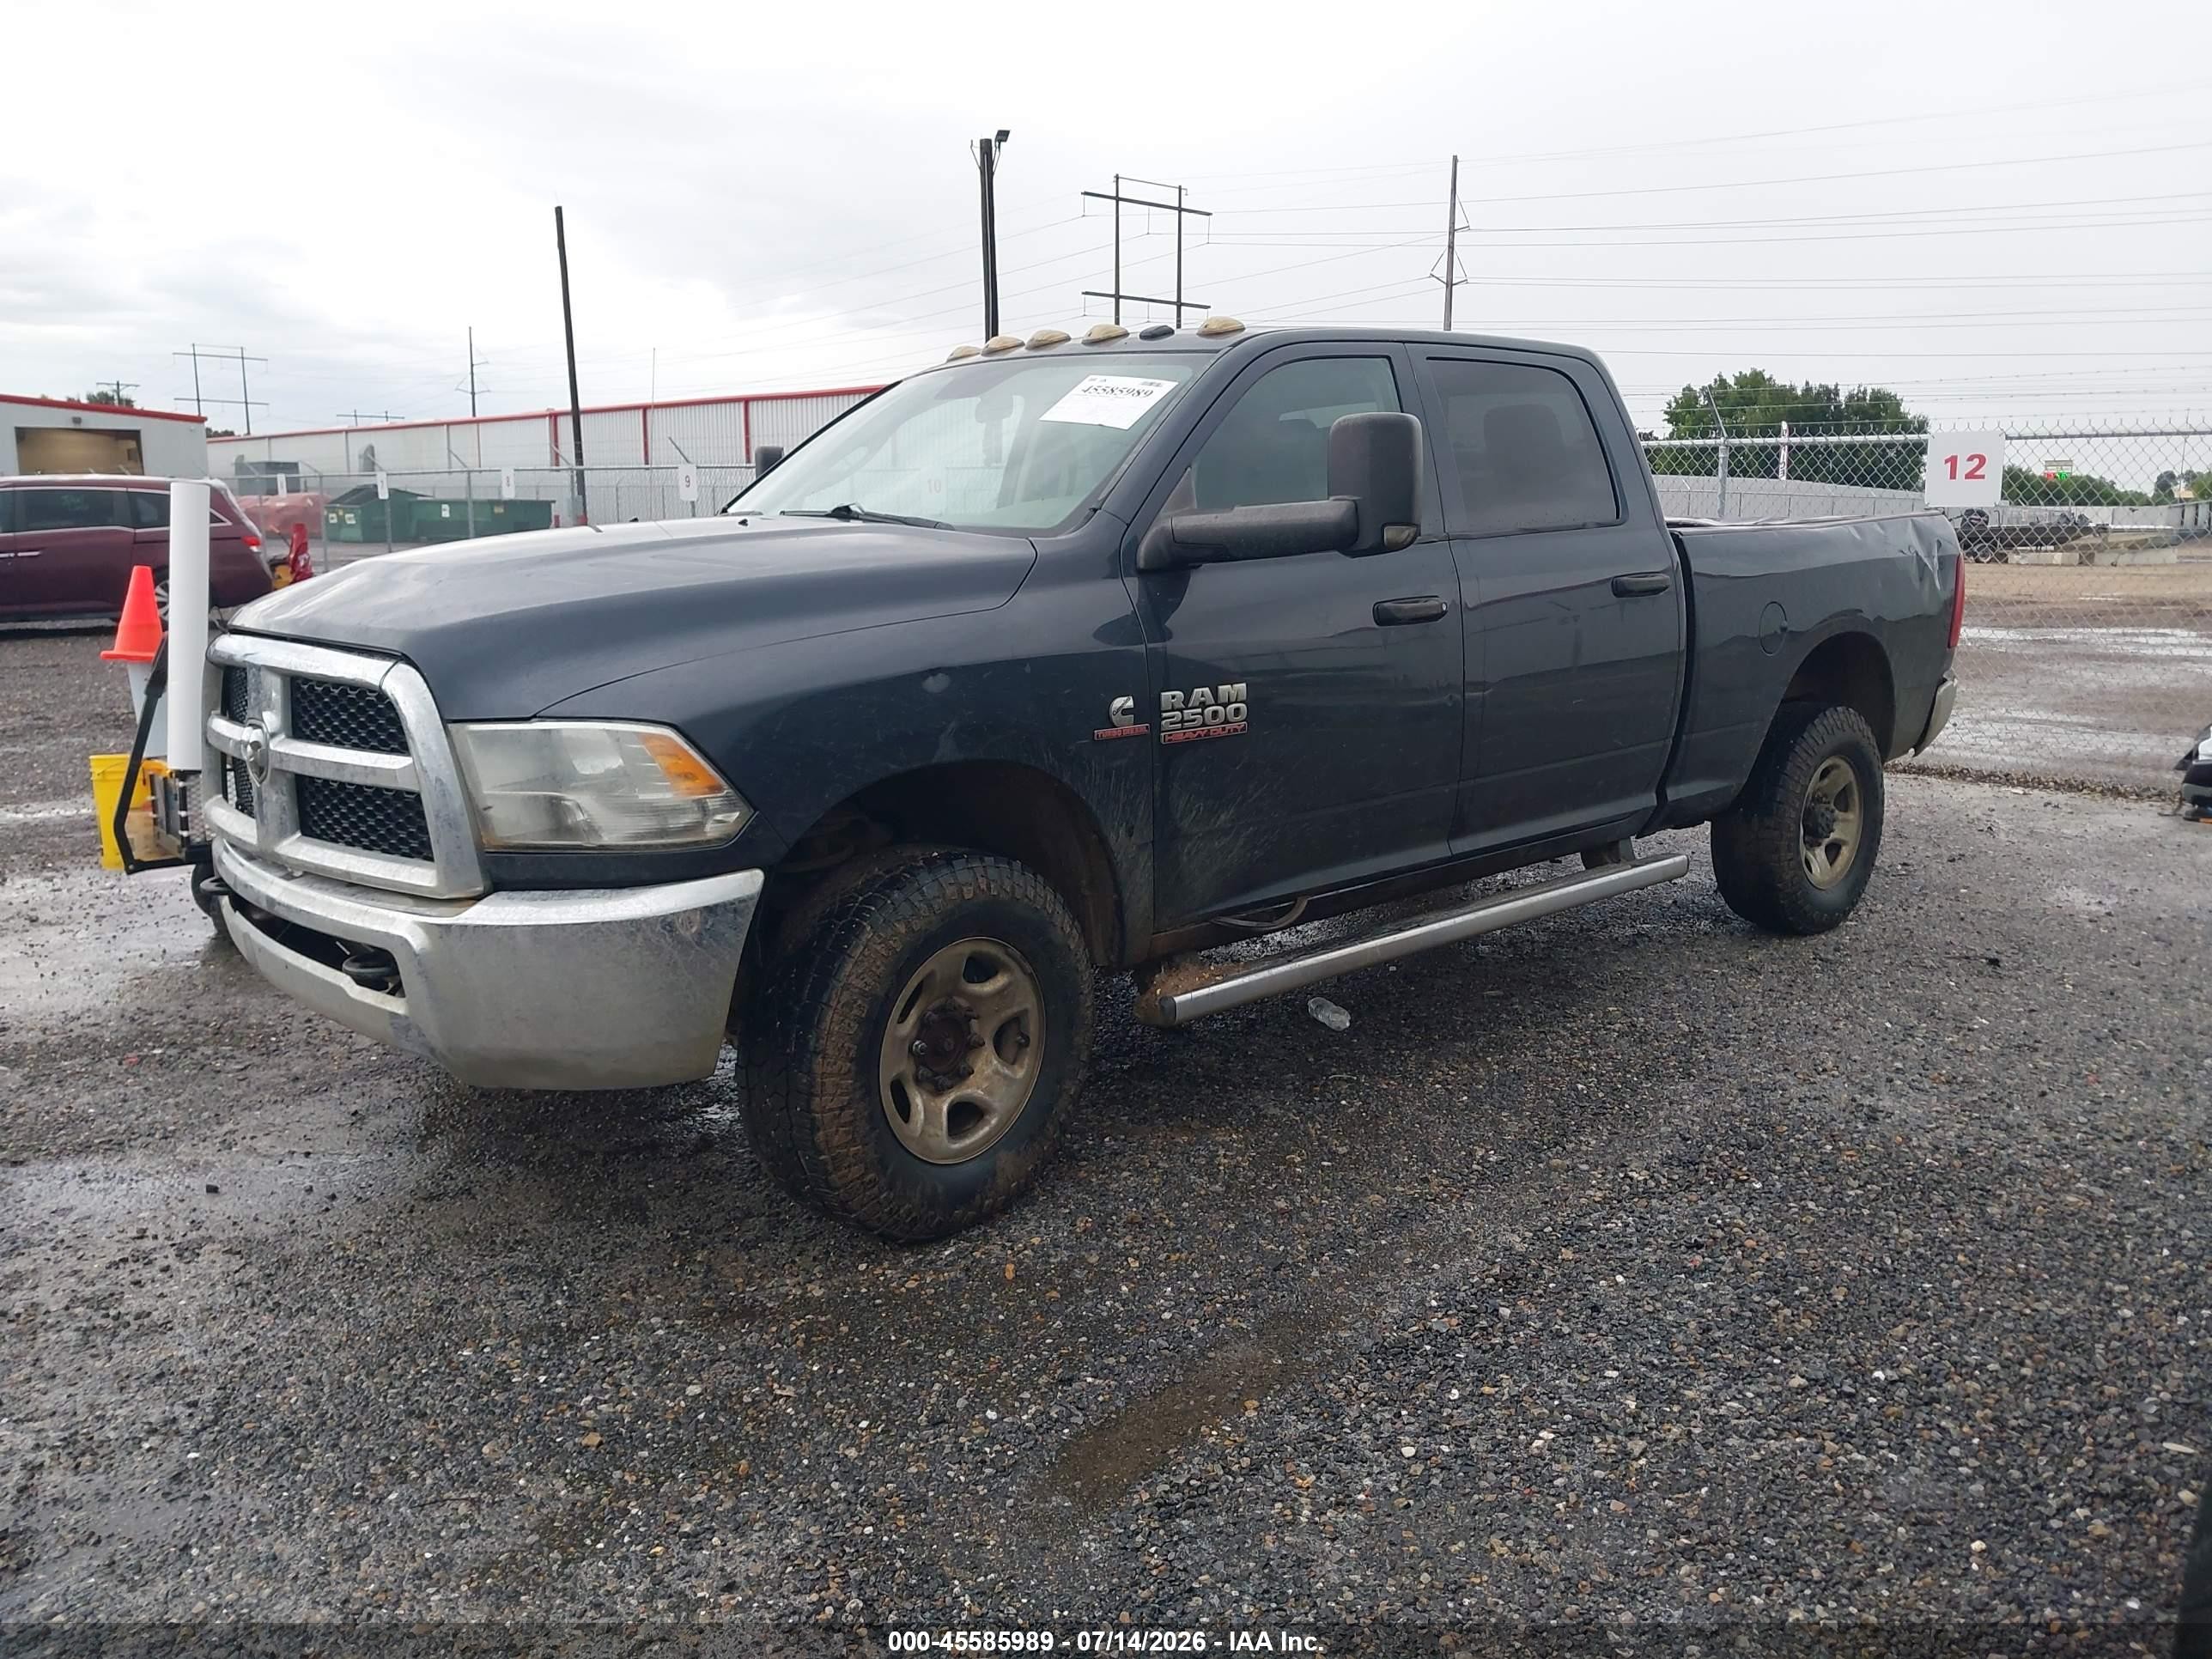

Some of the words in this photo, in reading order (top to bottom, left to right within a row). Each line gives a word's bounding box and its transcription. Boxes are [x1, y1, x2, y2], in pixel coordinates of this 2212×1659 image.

[1081, 385, 1154, 398] 45585989
[1944, 454, 1986, 480] 12
[684, 475, 691, 488] 9
[927, 479, 942, 495] 10
[1161, 683, 1247, 711] RAM
[1161, 703, 1248, 731] 2500
[1164, 730, 1208, 742] HEAVY
[1210, 725, 1245, 736] DUTY
